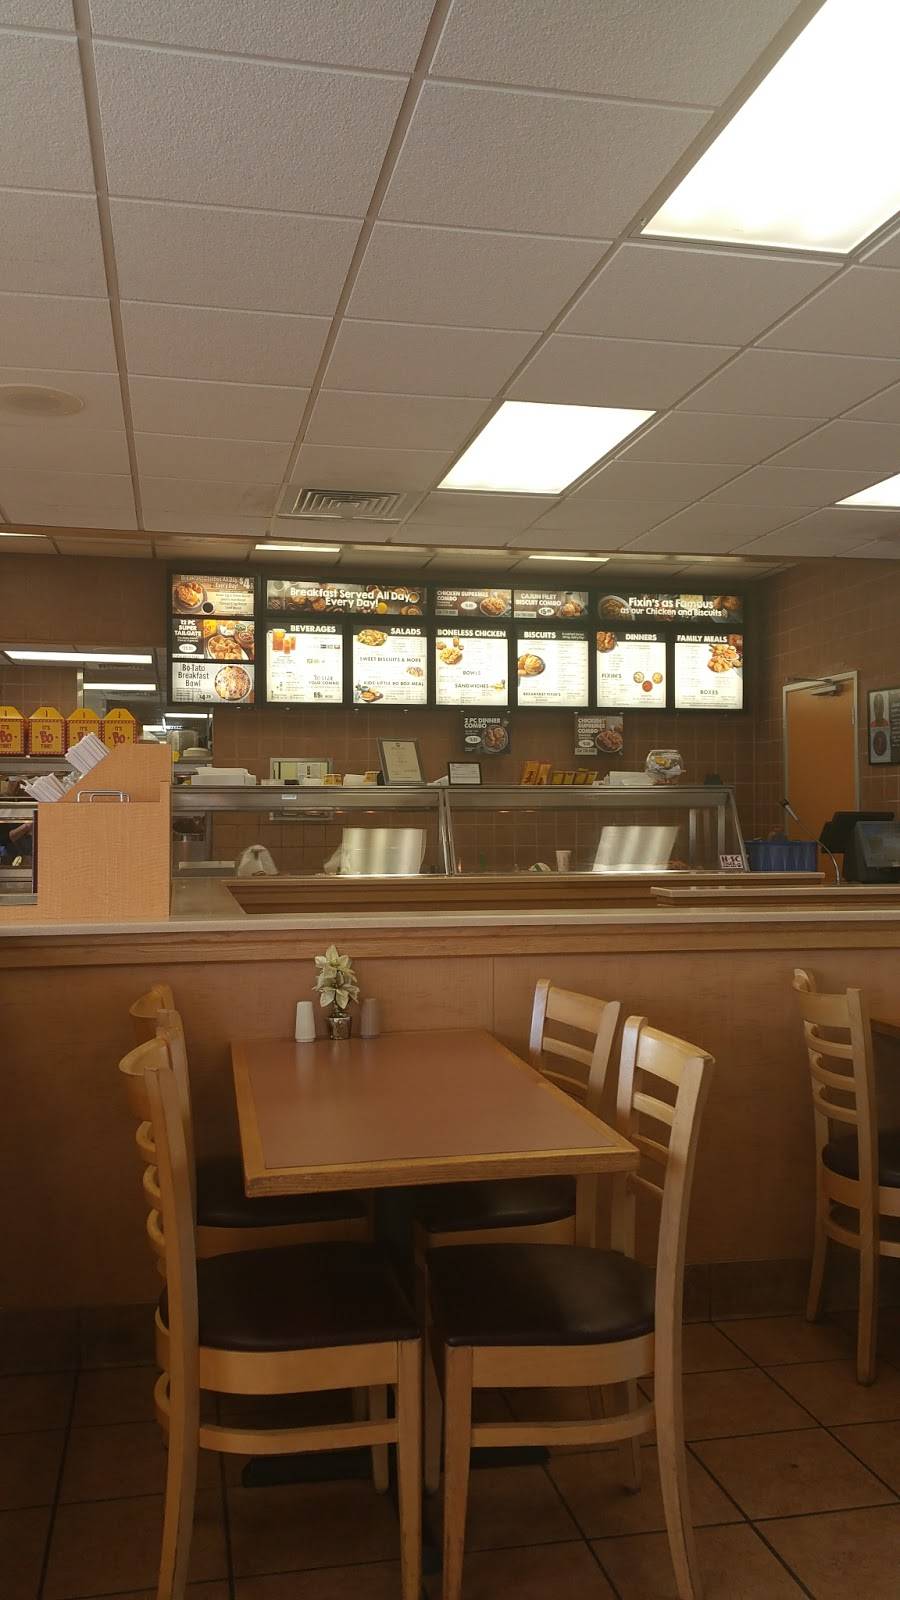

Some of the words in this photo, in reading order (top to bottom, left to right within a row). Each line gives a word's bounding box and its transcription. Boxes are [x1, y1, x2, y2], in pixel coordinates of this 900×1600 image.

[290, 588, 338, 597] Breakfast
[339, 589, 374, 599] Served
[377, 591, 389, 600] All
[326, 598, 354, 608] Every
[356, 598, 378, 608] Day!
[628, 597, 660, 608] Fixin's
[662, 600, 674, 608] as
[676, 599, 714, 609] Famous
[646, 608, 676, 616] Chicken
[694, 609, 722, 617] Biscuits
